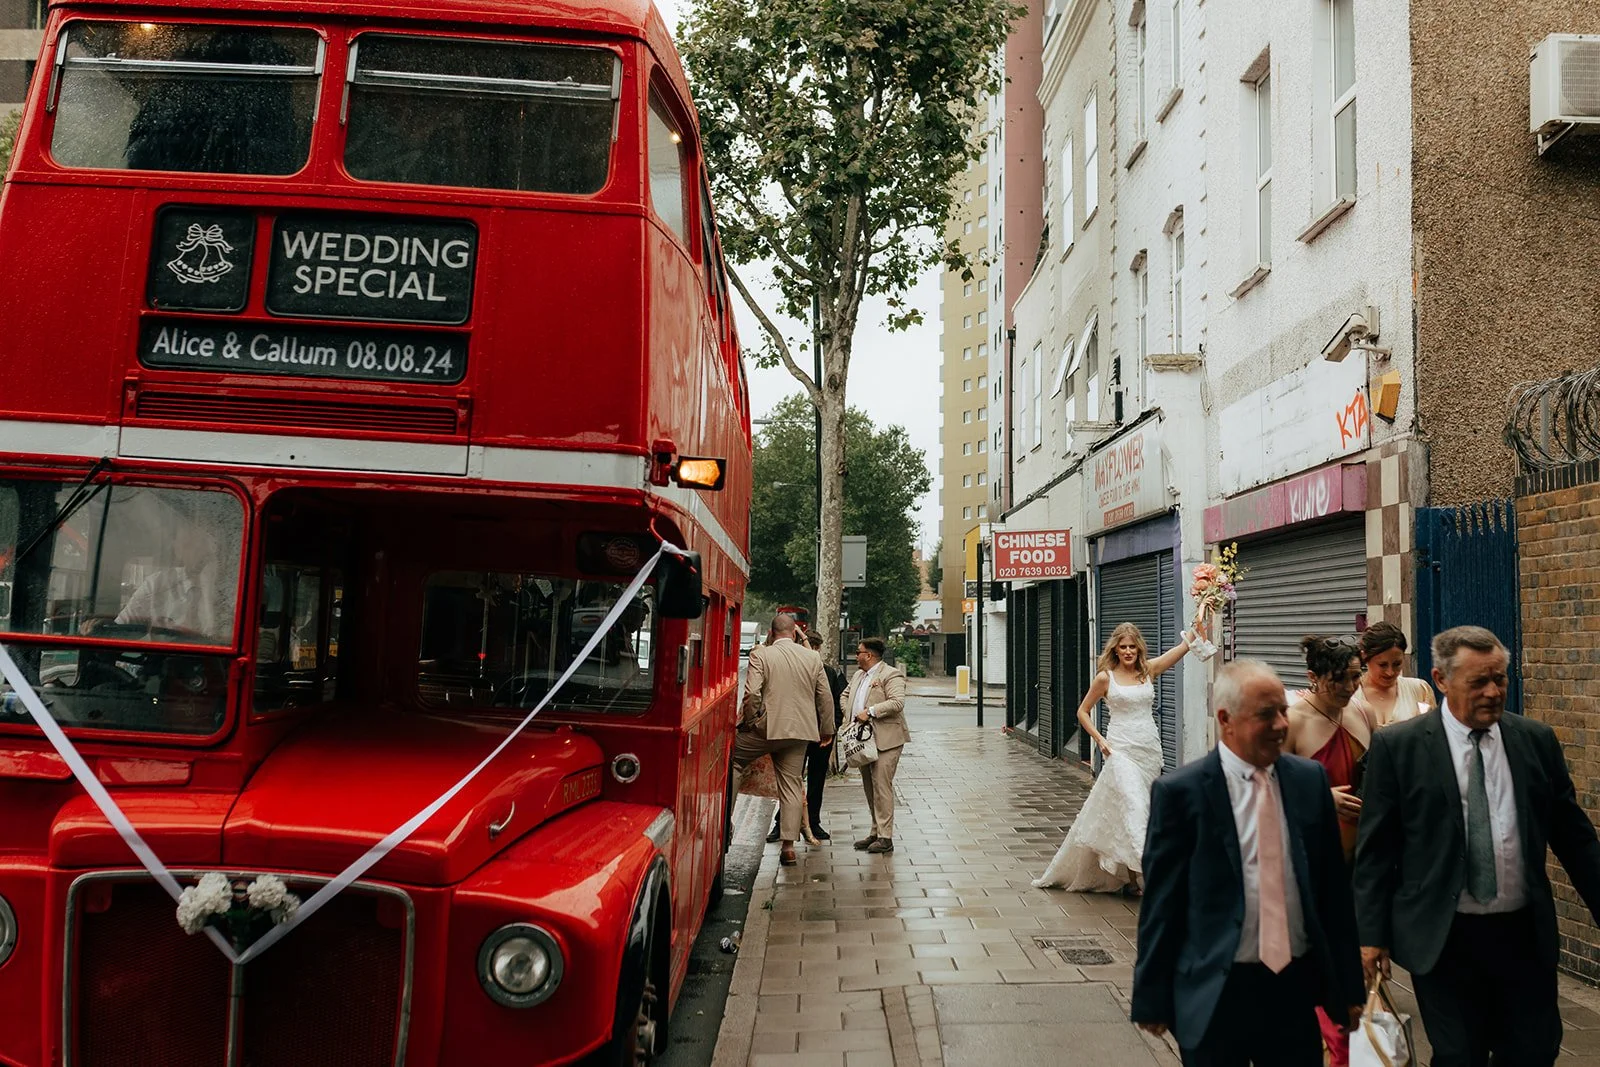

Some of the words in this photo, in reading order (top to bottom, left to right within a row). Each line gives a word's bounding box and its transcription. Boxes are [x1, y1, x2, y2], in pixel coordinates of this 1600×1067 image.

[282, 230, 470, 269] WEDDING
[293, 265, 447, 302] SPECIAL
[152, 326, 215, 359] Alice
[222, 331, 243, 360] &
[250, 334, 337, 367] Callum
[346, 341, 453, 375] 08.08.24
[998, 532, 1067, 549] CHINESE
[1009, 549, 1056, 564] FOOD
[999, 567, 1017, 577] 020
[1019, 567, 1042, 576] 7639
[1044, 566, 1068, 575] 0032
